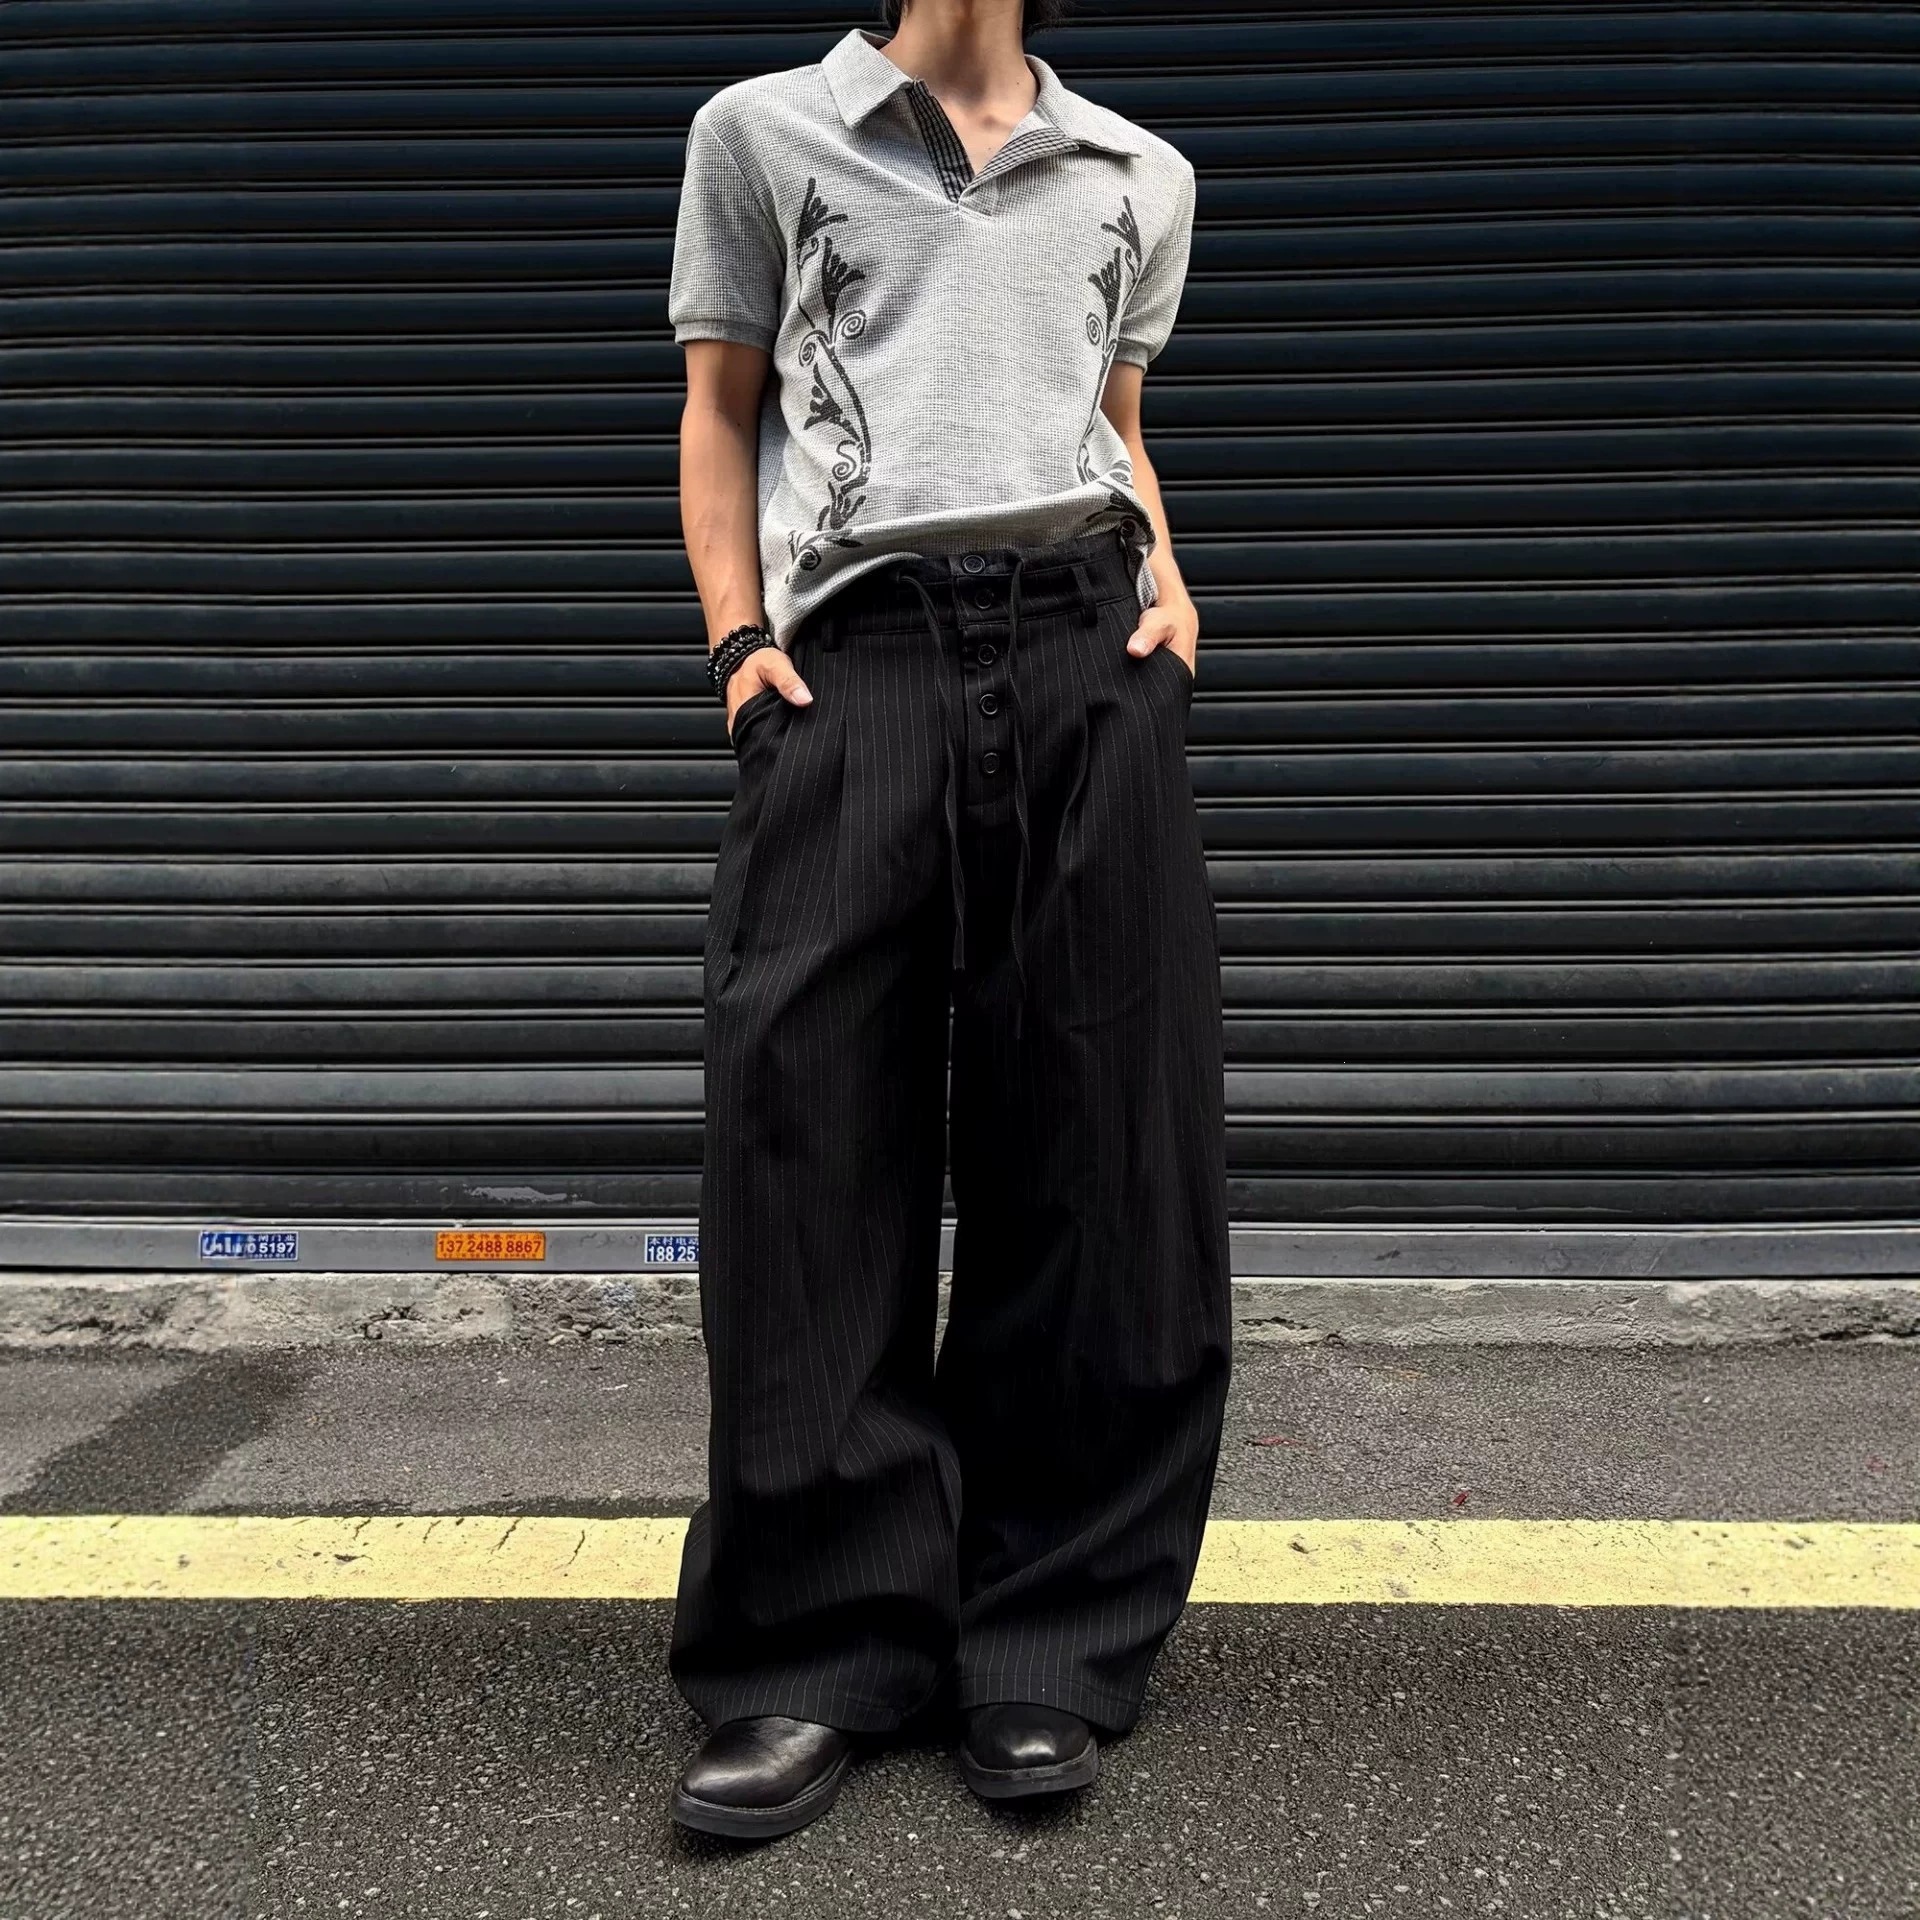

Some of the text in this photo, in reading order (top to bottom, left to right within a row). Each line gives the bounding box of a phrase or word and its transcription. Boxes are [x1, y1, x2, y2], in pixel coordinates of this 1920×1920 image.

[438, 1240, 542, 1253] 137 2488 8867
[648, 1246, 699, 1262] 188 25
